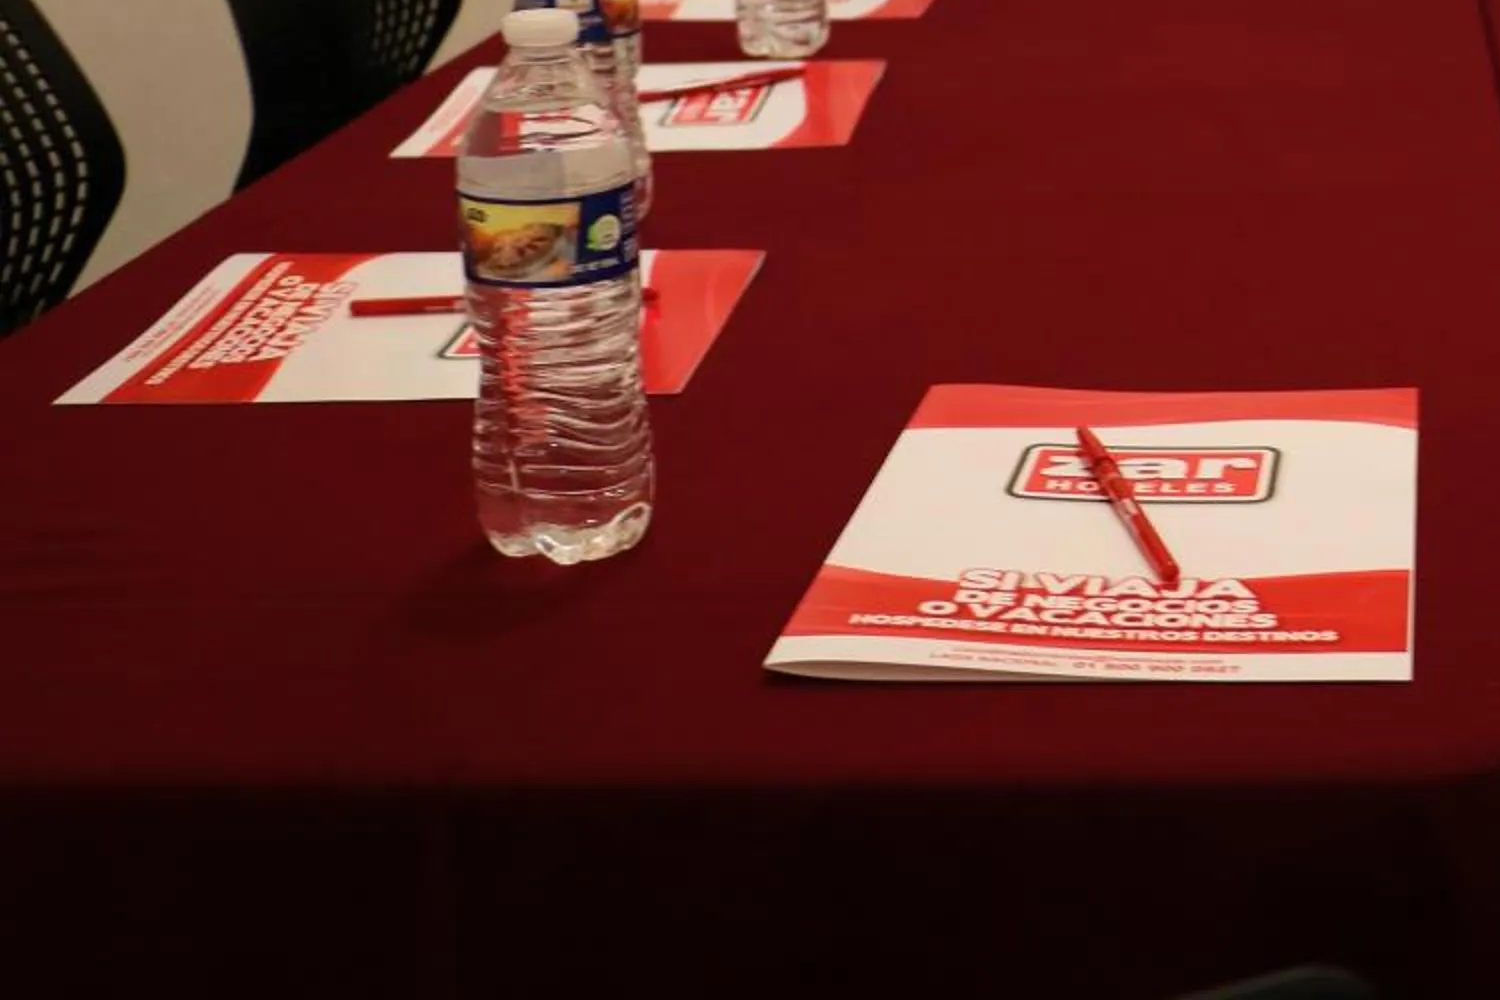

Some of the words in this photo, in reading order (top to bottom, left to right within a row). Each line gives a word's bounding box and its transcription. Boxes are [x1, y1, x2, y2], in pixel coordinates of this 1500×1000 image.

[248, 300, 344, 361] VIAJA
[1044, 480, 1236, 493] HOELES
[960, 568, 1021, 591] SI
[1034, 571, 1257, 599] VIAJA
[954, 589, 1017, 606] DE
[1023, 594, 1260, 613] NEGOCIOS
[917, 601, 958, 615] O
[968, 603, 1278, 628] VACACIONES
[1010, 623, 1047, 636] EN
[1050, 625, 1198, 642] NUESTROS
[1202, 630, 1339, 642] DESTINOS
